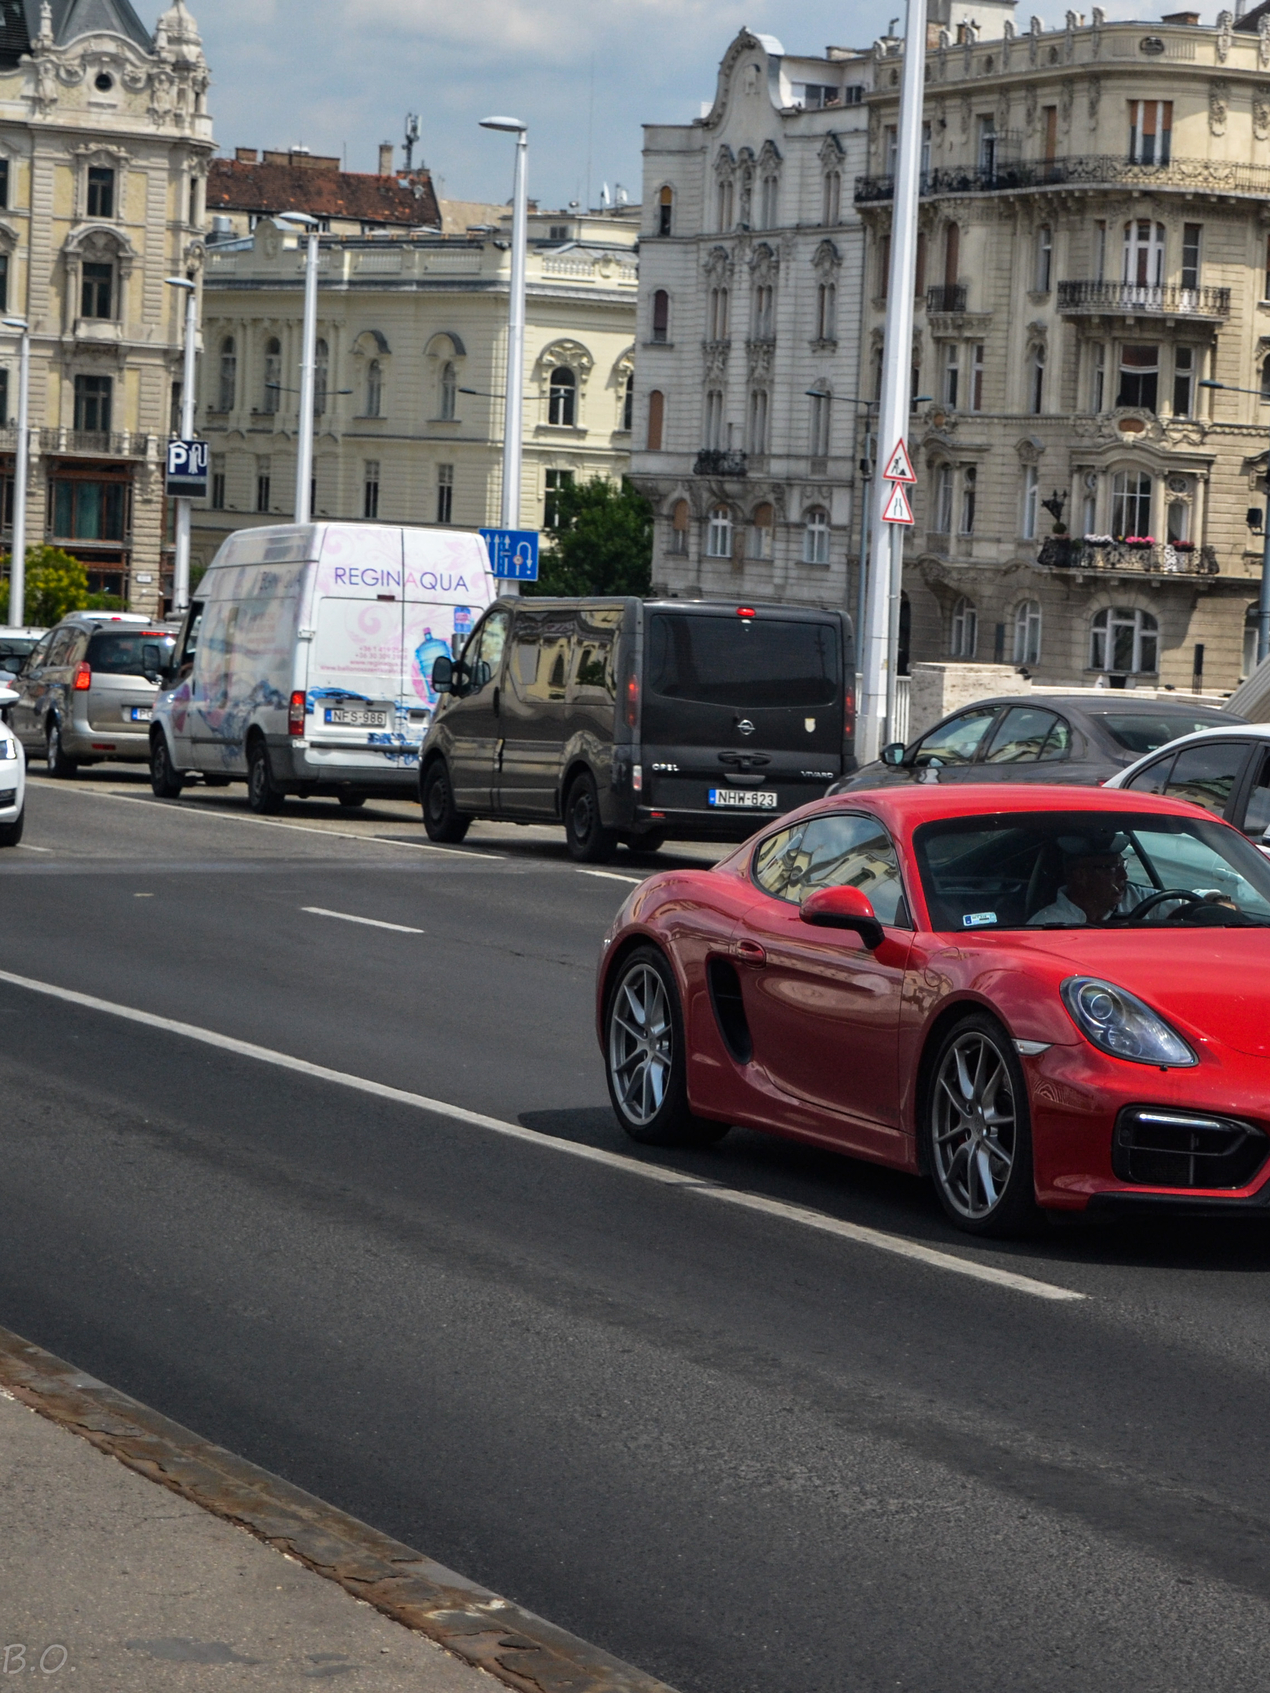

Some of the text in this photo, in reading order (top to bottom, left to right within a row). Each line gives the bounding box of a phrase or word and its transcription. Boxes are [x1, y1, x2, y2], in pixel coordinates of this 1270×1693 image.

[169, 447, 187, 473] P
[333, 711, 384, 723] NFS-986
[718, 791, 774, 806] NHW-623
